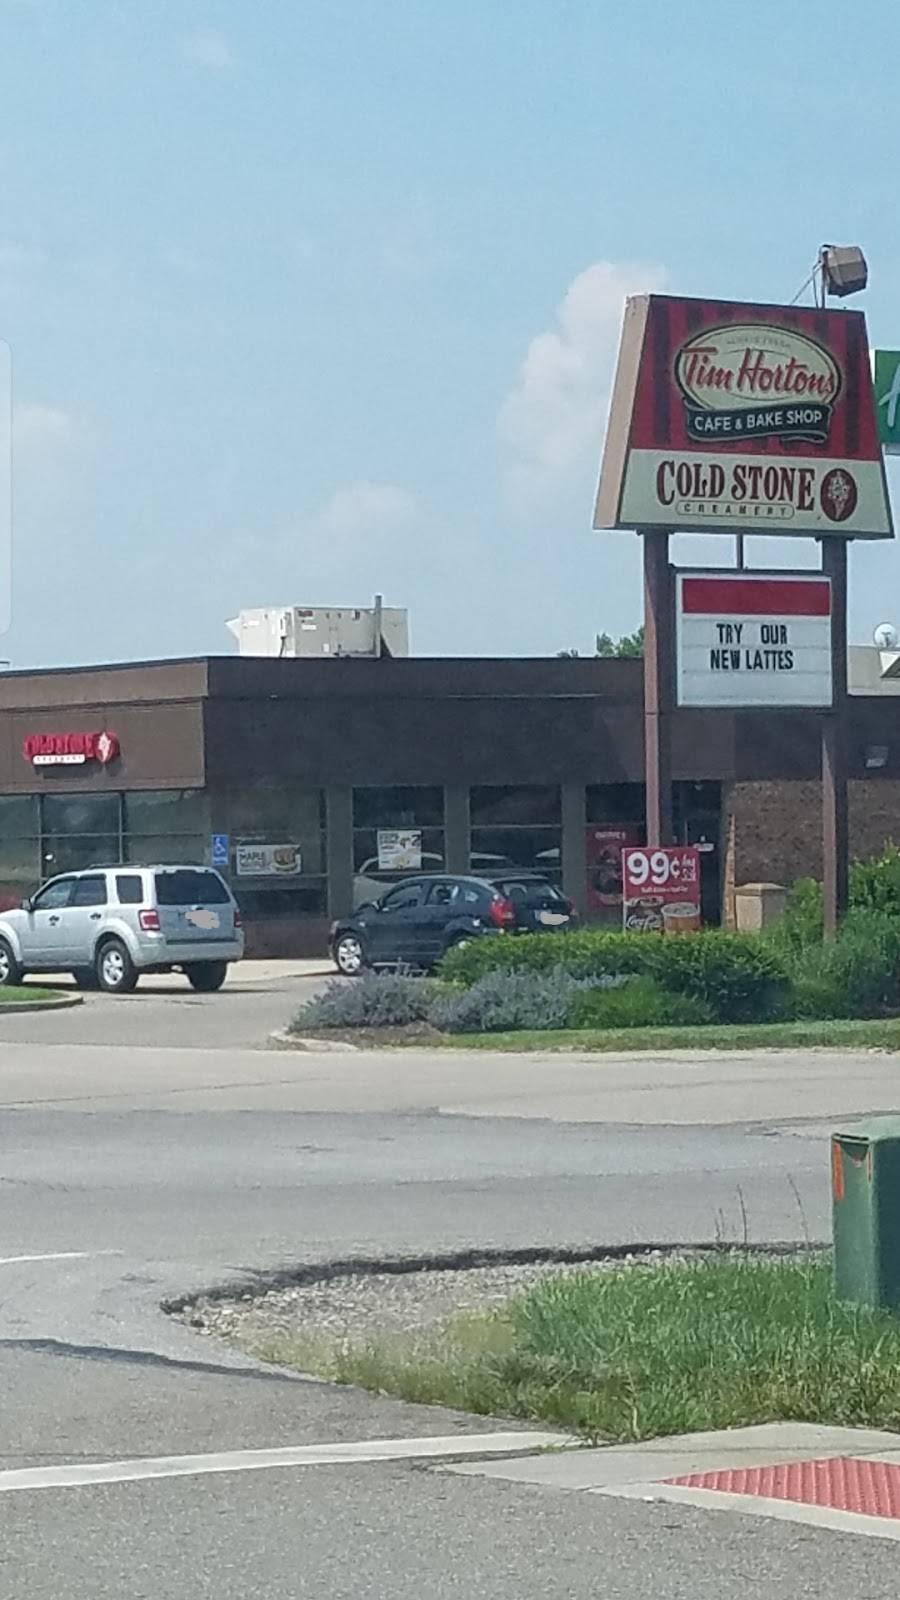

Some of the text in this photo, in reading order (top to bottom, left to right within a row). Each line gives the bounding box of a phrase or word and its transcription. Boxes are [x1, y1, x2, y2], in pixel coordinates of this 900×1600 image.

[680, 346, 835, 401] Tim Hortons
[694, 409, 823, 431] CAFE & BAKE SHOP
[656, 460, 816, 512] COLD STONE
[683, 502, 788, 518] CREAMERY
[716, 623, 788, 645] TRY OUR
[710, 649, 794, 672] NEW LATTES
